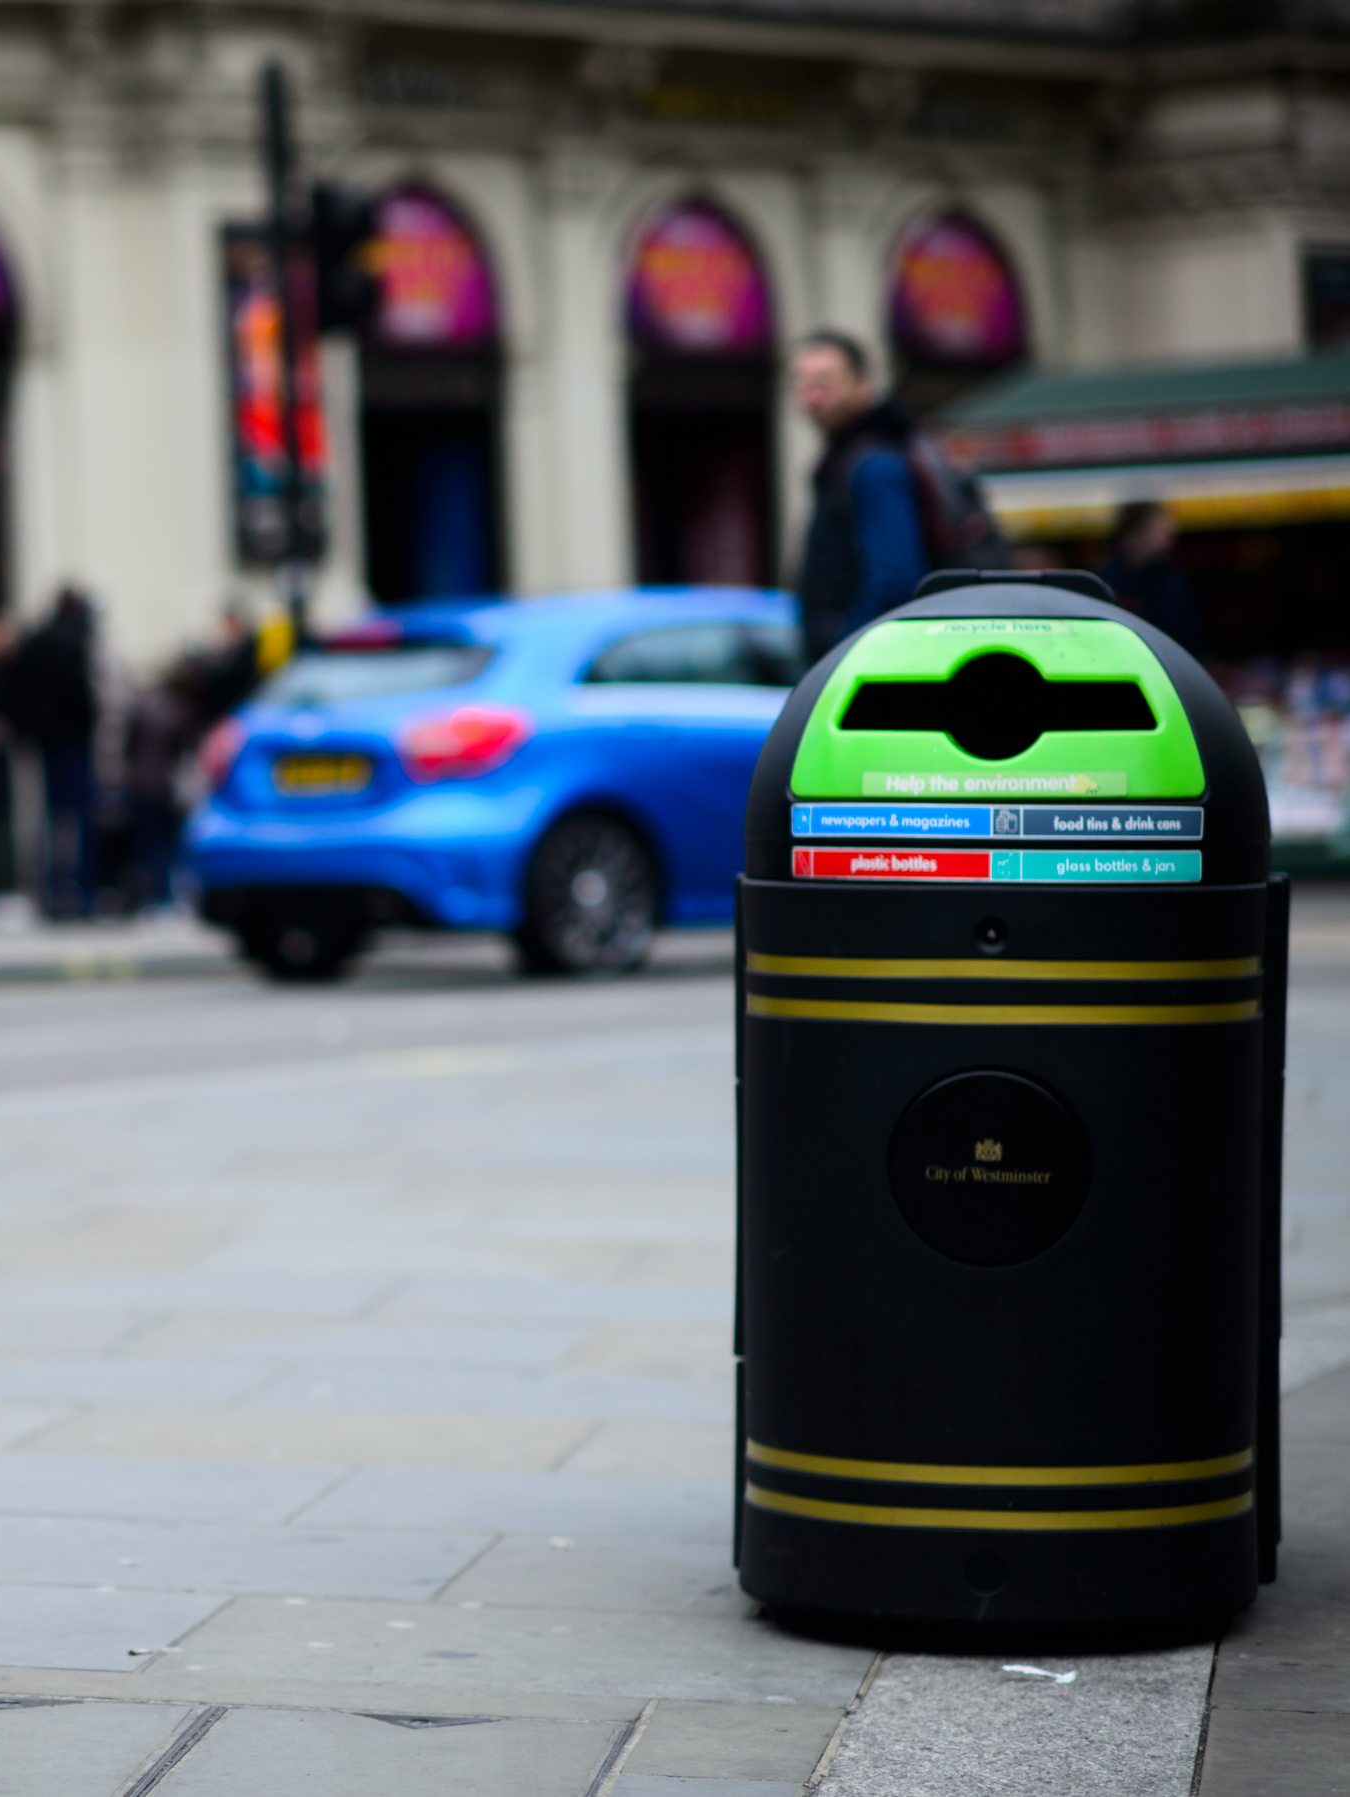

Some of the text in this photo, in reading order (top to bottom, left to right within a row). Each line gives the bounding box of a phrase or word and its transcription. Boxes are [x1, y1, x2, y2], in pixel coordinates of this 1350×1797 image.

[1012, 619, 1053, 632] here
[886, 774, 1077, 795] Help the environment
[821, 813, 970, 830] newspapers & magazines
[1053, 815, 1182, 831] food tins & drink cans
[850, 854, 938, 874] plastic bottles
[1056, 857, 1176, 875] glass bottles & jars
[924, 1164, 1052, 1185] City of Westminster
